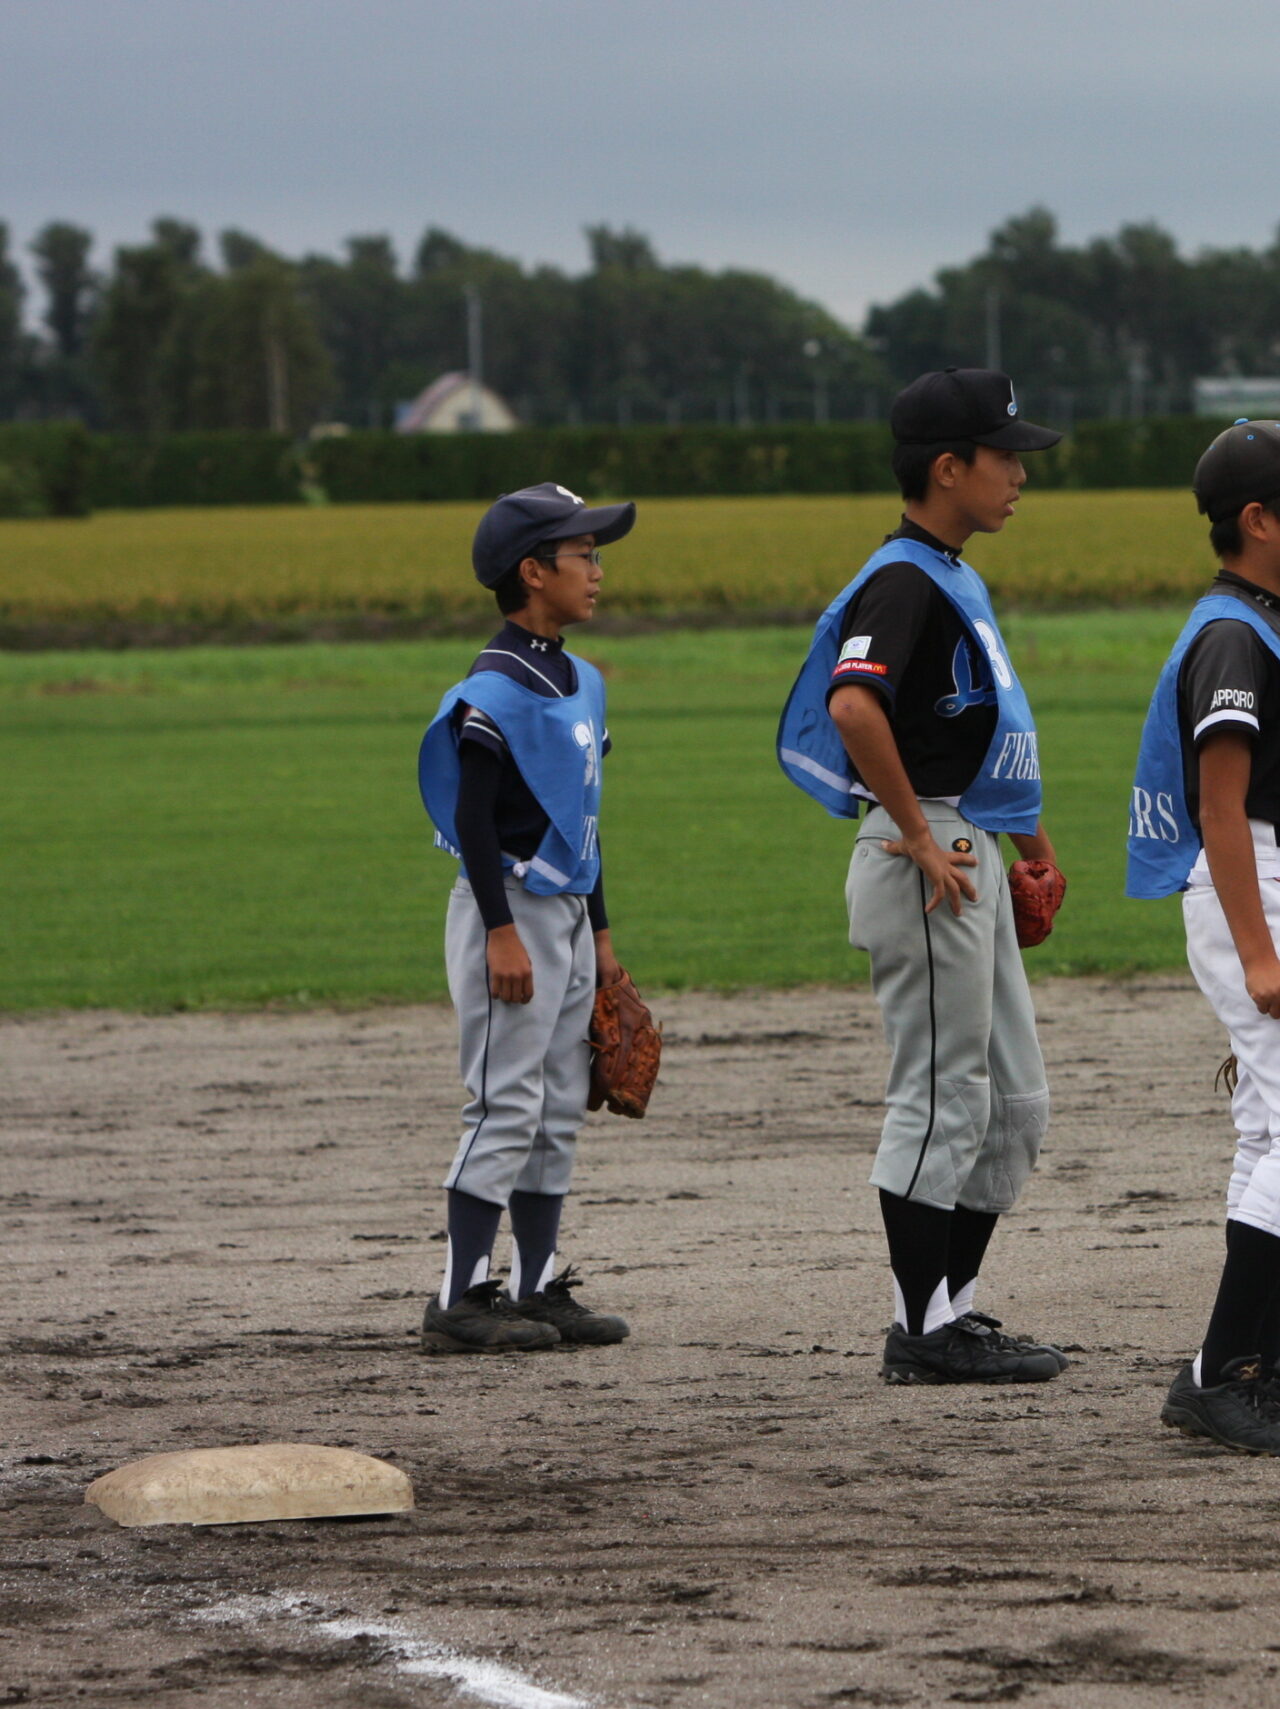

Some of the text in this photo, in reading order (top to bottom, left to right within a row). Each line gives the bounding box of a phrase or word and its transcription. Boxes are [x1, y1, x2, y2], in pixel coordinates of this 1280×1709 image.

[1210, 688, 1254, 710] APPORO
[990, 731, 1041, 780] FIGH
[1128, 786, 1180, 843] RS
